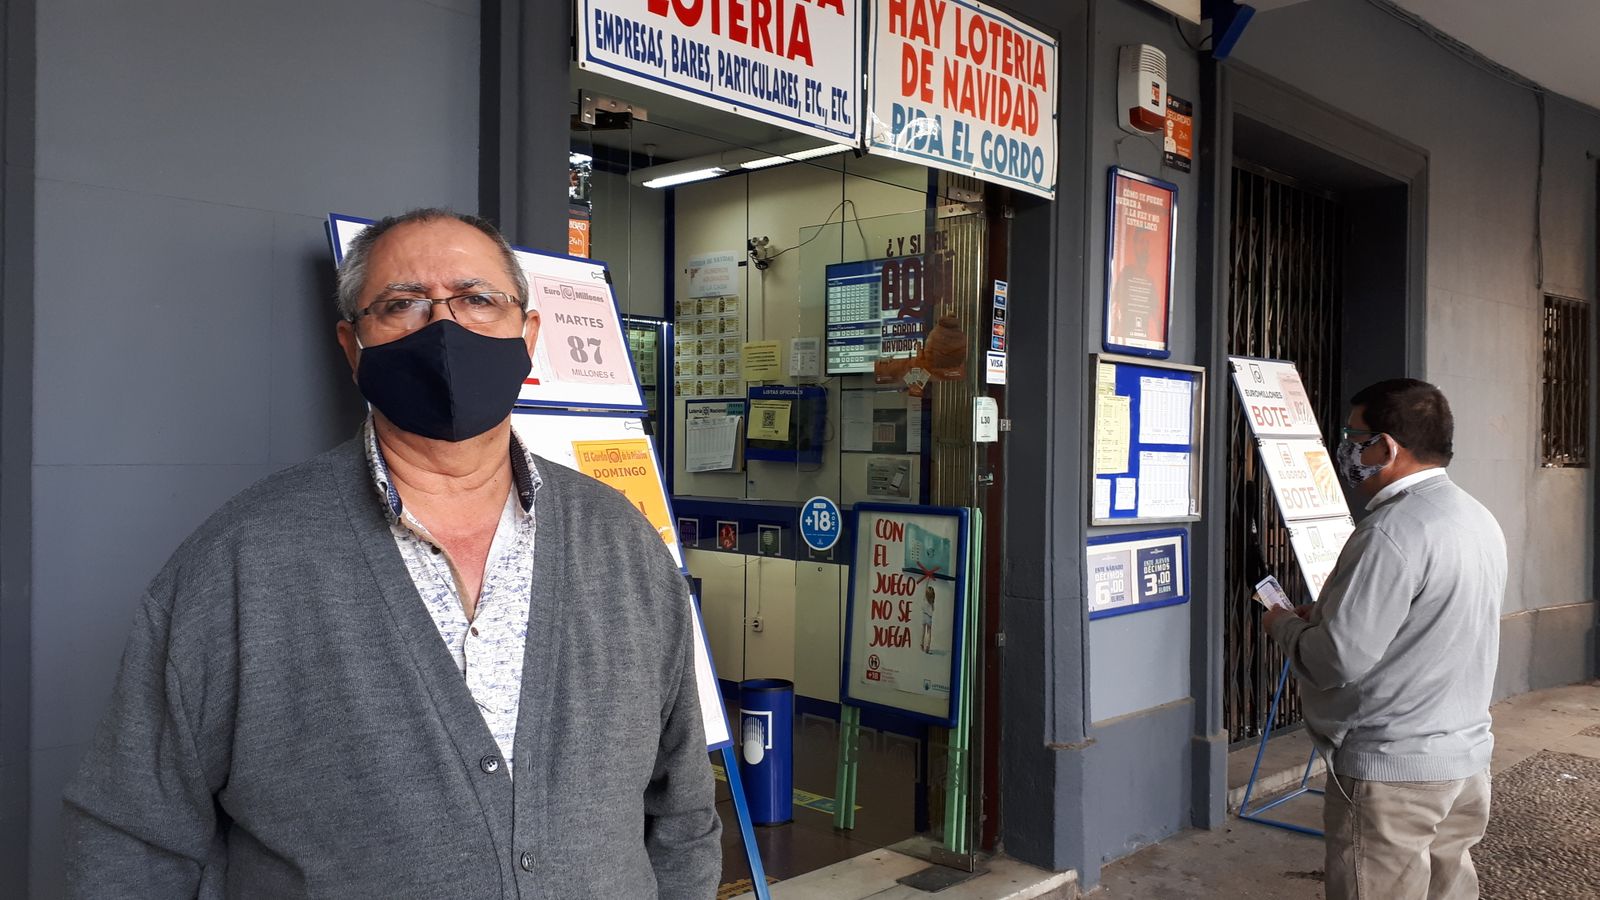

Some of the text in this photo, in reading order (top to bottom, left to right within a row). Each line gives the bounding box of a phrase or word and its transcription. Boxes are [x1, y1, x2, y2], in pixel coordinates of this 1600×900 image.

[647, 0, 814, 67] TERIA
[888, 0, 1047, 92] HAY LOTERIA
[594, 8, 851, 125] EMPRESAS, BARES, PARTICULARES, ETC., ETC.
[901, 41, 1039, 137] DE NAVIDAD
[891, 102, 1044, 184] PIDA EL GORDO
[910, 234, 921, 254] SI
[543, 286, 561, 296] Euro
[554, 312, 604, 329] MARTES
[567, 335, 603, 365] 87
[571, 368, 616, 379] MILLONES €
[990, 358, 1004, 368] VISA
[1244, 389, 1283, 399] EUROMILLONES
[980, 416, 991, 425] L30
[1251, 405, 1292, 427] BOTE
[593, 466, 647, 478] DOMINGO
[1281, 487, 1320, 509] BOTE
[805, 510, 831, 531] +18
[875, 518, 904, 542] CON
[873, 544, 889, 567] EL
[872, 571, 916, 596] JUEGO
[871, 599, 913, 623] NO SE
[869, 625, 911, 648] JUEGA
